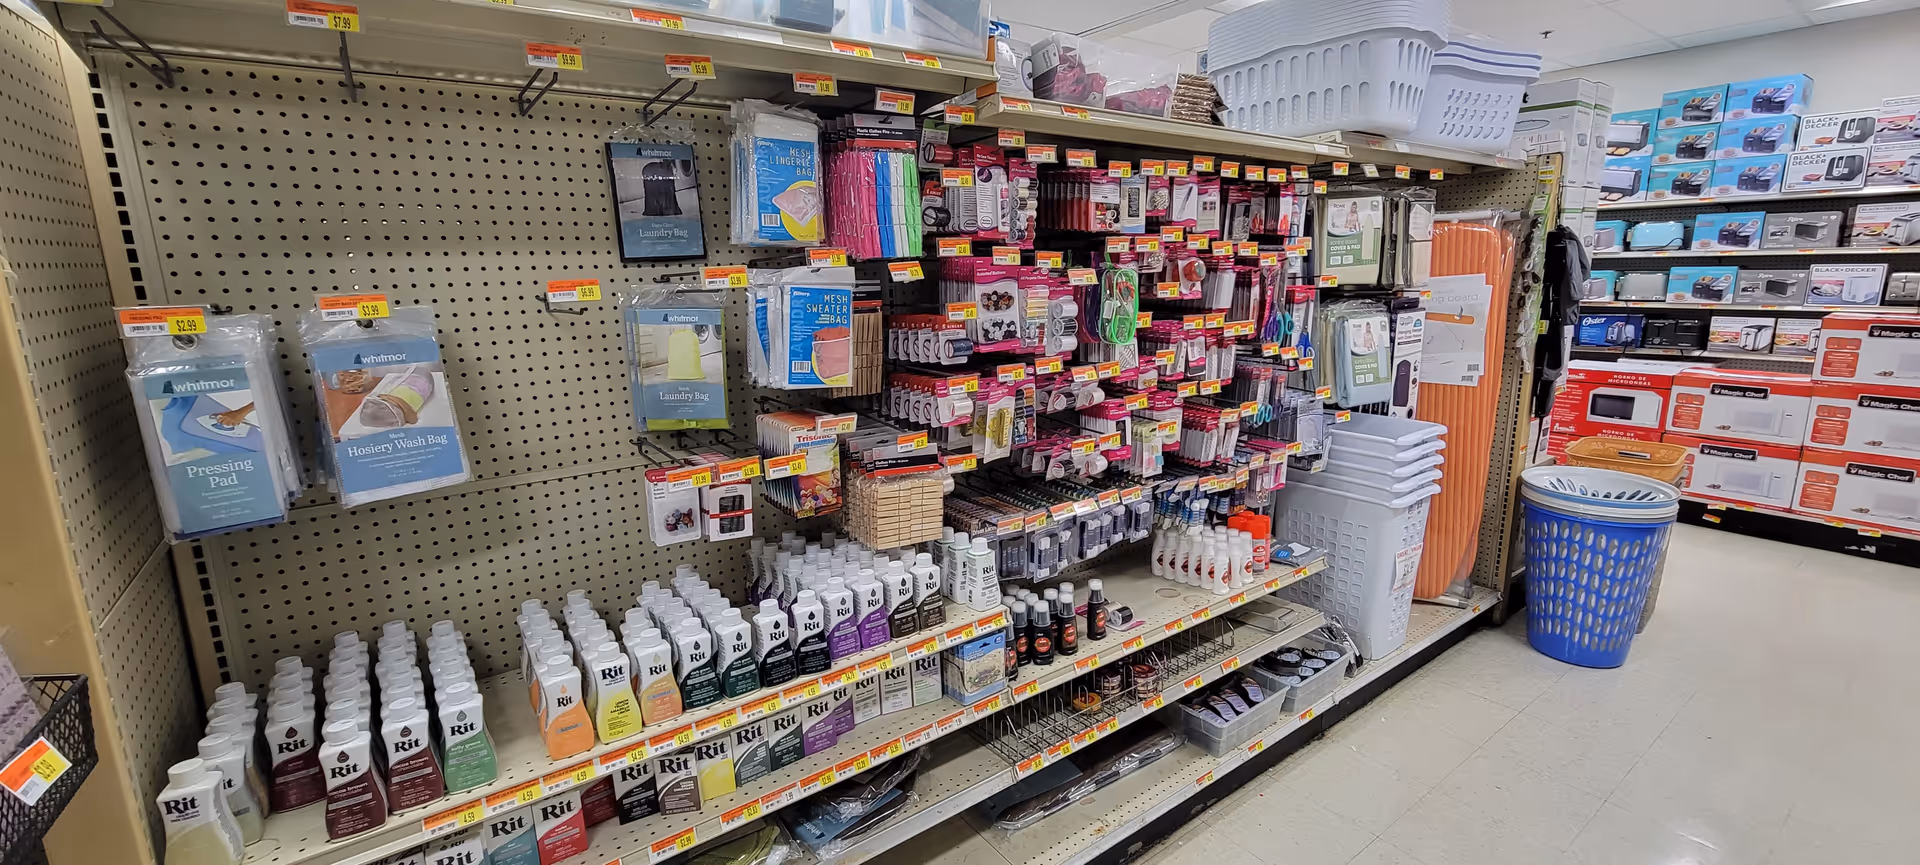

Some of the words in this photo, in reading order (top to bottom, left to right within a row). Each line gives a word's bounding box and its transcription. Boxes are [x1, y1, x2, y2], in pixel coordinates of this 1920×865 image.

[333, 15, 351, 29] $7.99
[561, 54, 576, 66] $9.99
[695, 64, 707, 74] $5.99
[1804, 121, 1839, 129] DECKER
[1805, 116, 1839, 124] BLACK+
[789, 147, 811, 157] MESH
[1792, 153, 1827, 161] BLACK+
[768, 156, 811, 167] LINGERIE
[796, 167, 812, 177] BAG
[639, 228, 673, 240] Laundry
[674, 228, 688, 239] Bag
[581, 287, 594, 298] $6.99
[824, 294, 848, 304] MESH
[362, 304, 379, 317] $3.99
[806, 303, 848, 314] SWEATER
[668, 314, 699, 323] whitmor
[830, 314, 848, 325] BAG
[1582, 316, 1607, 327] Oster
[176, 319, 197, 332] $2.99
[1880, 330, 1910, 338] Magic
[361, 352, 407, 365] whitmor
[173, 377, 235, 393] whitmor
[1607, 378, 1652, 386] MICROONDAS
[659, 391, 694, 402] Laundry
[695, 391, 710, 401] Bag
[1720, 388, 1744, 397] Magic
[1745, 391, 1765, 399] Chef
[1870, 400, 1899, 409] Magic
[347, 442, 393, 457] Hosiery
[394, 436, 426, 450] Wash
[427, 434, 448, 445] Bag
[1710, 449, 1733, 457] Magic
[1733, 452, 1754, 460] Chef
[186, 459, 254, 478] Pressing
[209, 473, 239, 488] Pad
[1858, 468, 1886, 478] Magic
[1887, 472, 1911, 482] Chef
[982, 565, 994, 575] Rit
[898, 586, 910, 597] Rit
[925, 581, 937, 591] Rit
[867, 597, 880, 608] Rit
[836, 606, 851, 617] Rit
[804, 620, 821, 632] Rit
[769, 630, 786, 642] Rit
[732, 641, 748, 653] Rit
[690, 651, 707, 664] Rit
[649, 663, 668, 676] Rit
[915, 656, 937, 672] Rit
[600, 664, 625, 681] Rit
[885, 667, 908, 680] Rit
[556, 695, 574, 708] Rit
[807, 700, 831, 718] Rit
[450, 721, 477, 736] Rit
[723, 718, 732, 728] 4.59
[773, 713, 798, 732] Rit
[678, 734, 690, 745] $4.59
[736, 723, 764, 746] Rit
[277, 738, 309, 754] Rit
[393, 737, 423, 753] Rit
[697, 740, 728, 760] Rit
[409, 756, 429, 765] brown
[631, 750, 644, 762] $4.59
[330, 762, 362, 779] Rit
[659, 756, 692, 774] Rit
[577, 770, 587, 782] 4.59
[620, 762, 652, 782] Rit
[222, 777, 236, 790] it
[347, 781, 368, 791] brown
[522, 790, 533, 802] 4.59
[164, 796, 200, 815] Rit
[540, 799, 577, 821] Rit
[463, 811, 475, 824] 4.59
[489, 815, 528, 839] Rit
[680, 835, 693, 848] $2.99
[434, 850, 478, 865] Rit
